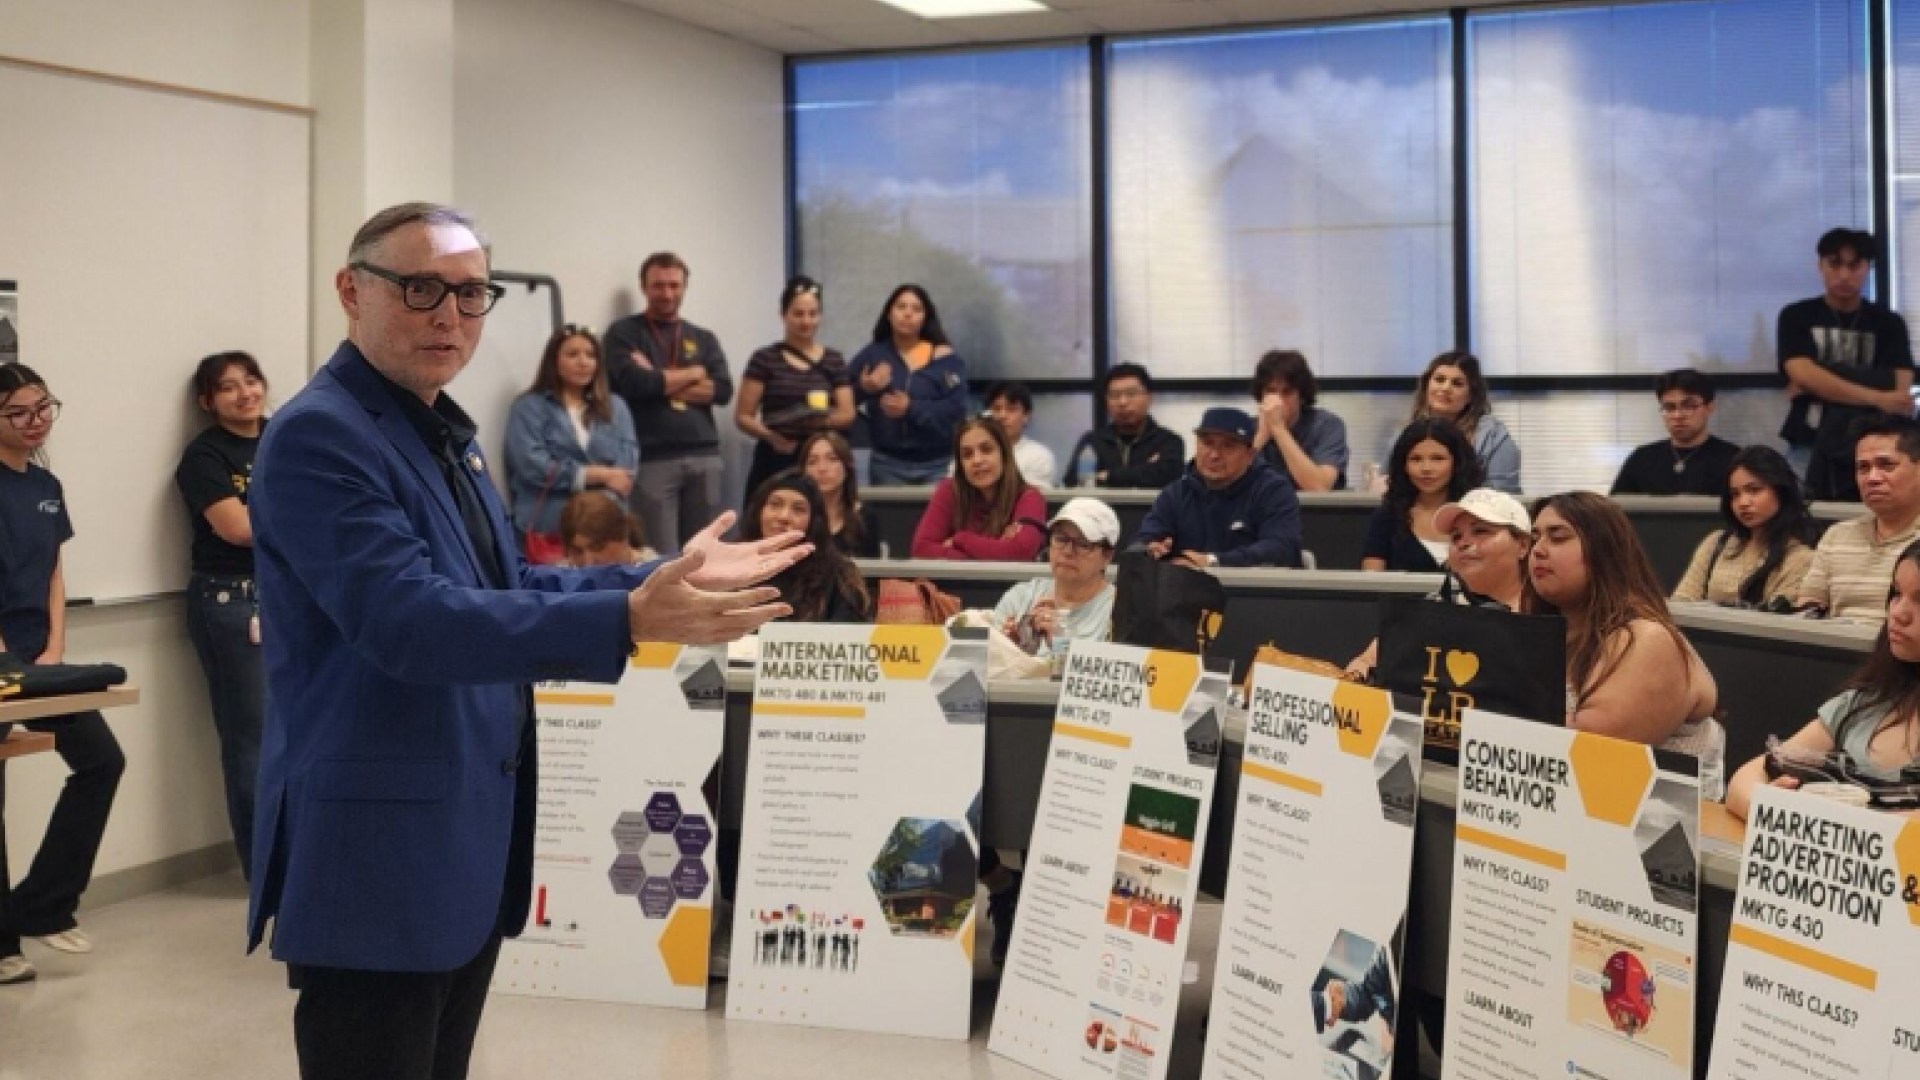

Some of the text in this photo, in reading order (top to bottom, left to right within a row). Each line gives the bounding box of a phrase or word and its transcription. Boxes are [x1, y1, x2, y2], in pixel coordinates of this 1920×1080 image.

[760, 662, 879, 683] MARKETING
[763, 641, 920, 663] INTERNATIONAL
[1070, 654, 1157, 687] MARKETING
[1423, 646, 1441, 682] I
[760, 688, 792, 700] MKTG
[830, 691, 863, 703] MKTG
[1065, 676, 1142, 707] RESEARCH
[1255, 686, 1362, 735] PROFESSIONAL
[1251, 710, 1309, 745] SELLING
[1465, 739, 1569, 787] CONSUMER
[1461, 798, 1495, 823] MKTG
[1463, 766, 1557, 813] BEHAVIOR
[1754, 803, 1883, 860] MARKETING
[1463, 853, 1550, 895] WHY THIS CLASS?
[1750, 834, 1920, 905] ADVERTISING &
[1576, 888, 1624, 915] STUDENT
[1626, 899, 1684, 937] PROJECTS
[1746, 861, 1883, 927] PROMOTION
[1740, 896, 1823, 941] MKTG 430
[1464, 989, 1533, 1029] LEARN ABOUT
[1743, 971, 1858, 1029] WHY THIS CLASS?
